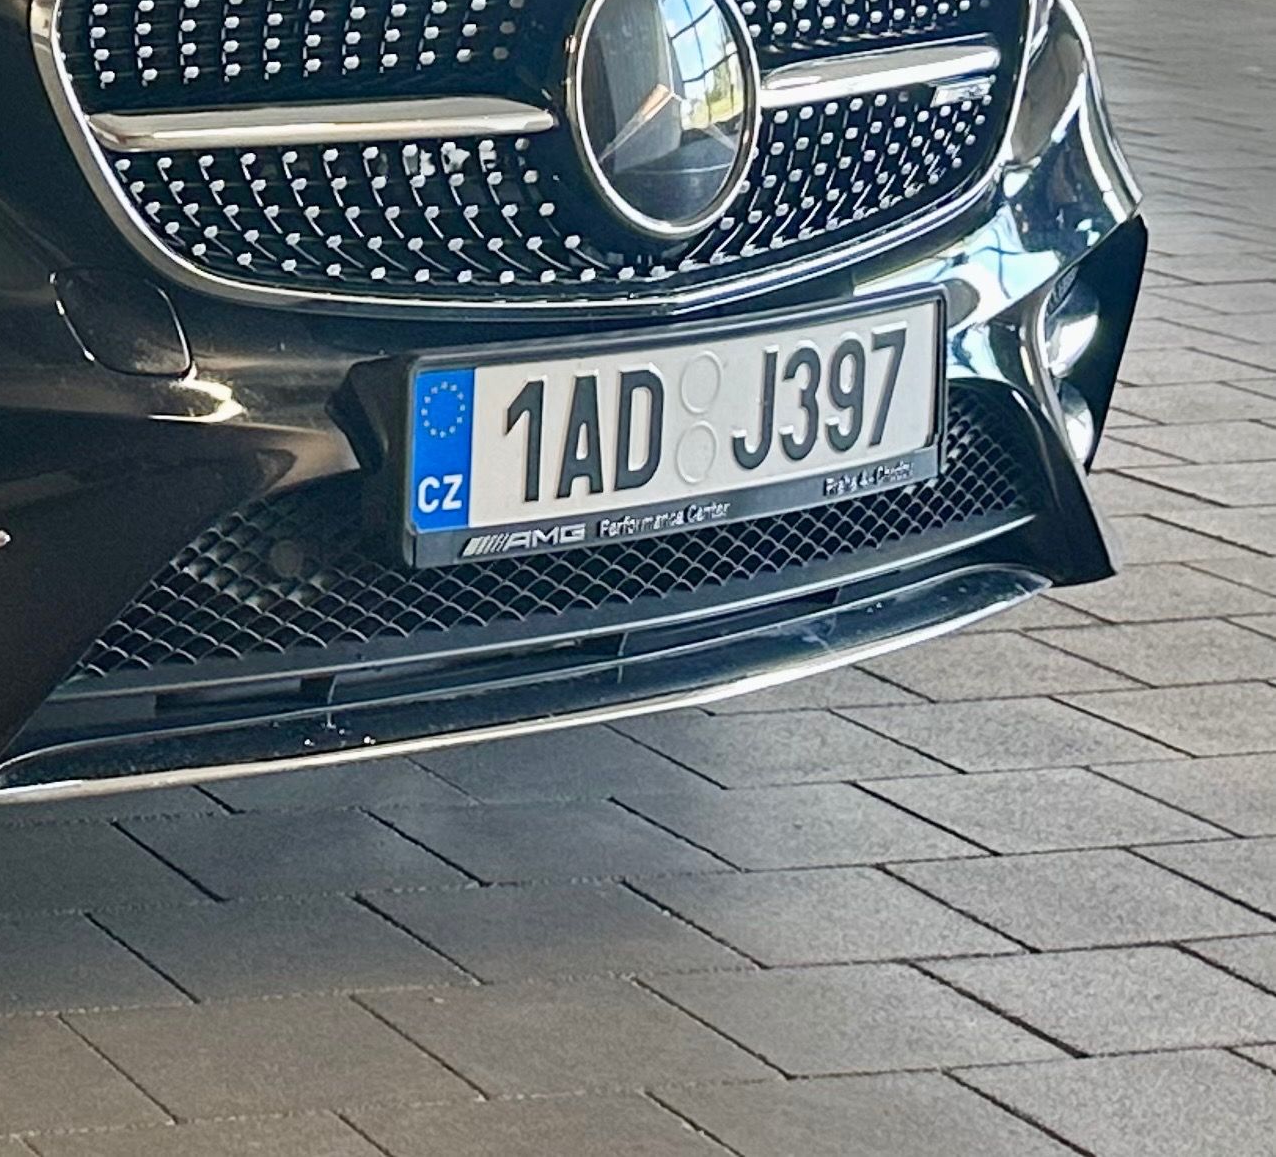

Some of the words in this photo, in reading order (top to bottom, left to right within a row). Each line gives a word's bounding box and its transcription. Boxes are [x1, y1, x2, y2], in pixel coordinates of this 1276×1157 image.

[417, 473, 464, 513] CZ
[504, 367, 664, 502] 1AD
[731, 323, 907, 470] J397
[504, 523, 587, 550] AMG
